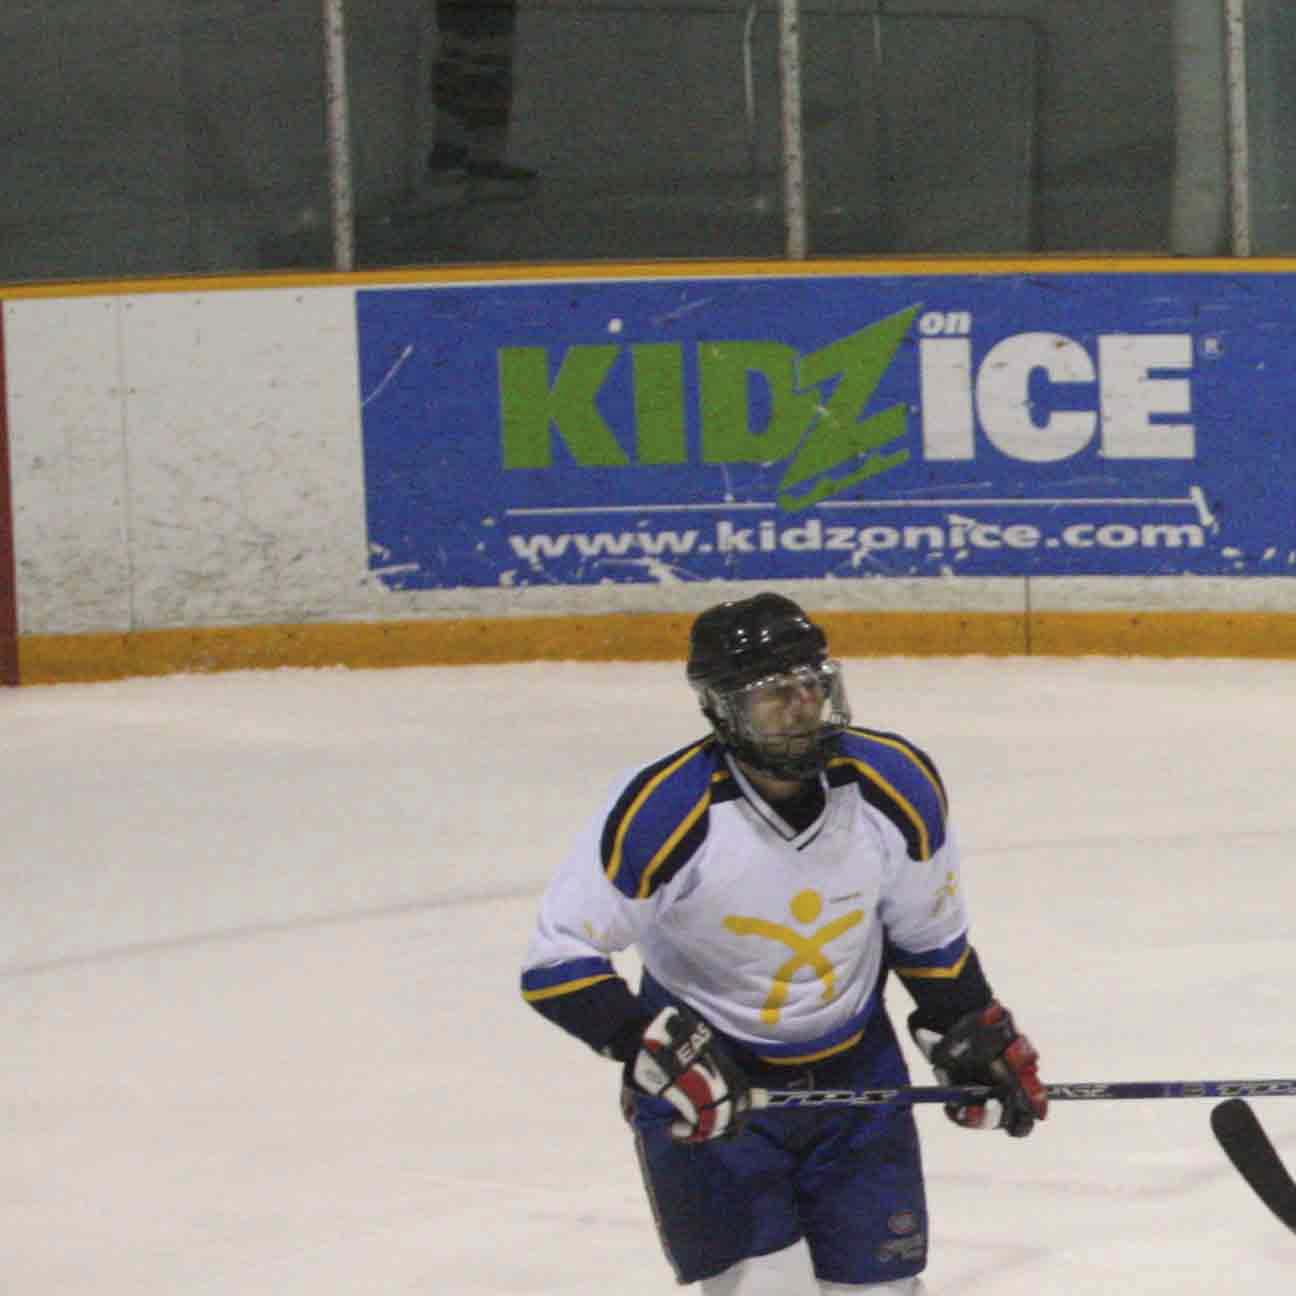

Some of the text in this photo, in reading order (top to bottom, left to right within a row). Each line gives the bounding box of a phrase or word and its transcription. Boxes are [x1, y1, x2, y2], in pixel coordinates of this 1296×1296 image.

[498, 302, 1196, 512] KIDZ on ICE
[509, 518, 1206, 558] www.kidzonice.com
